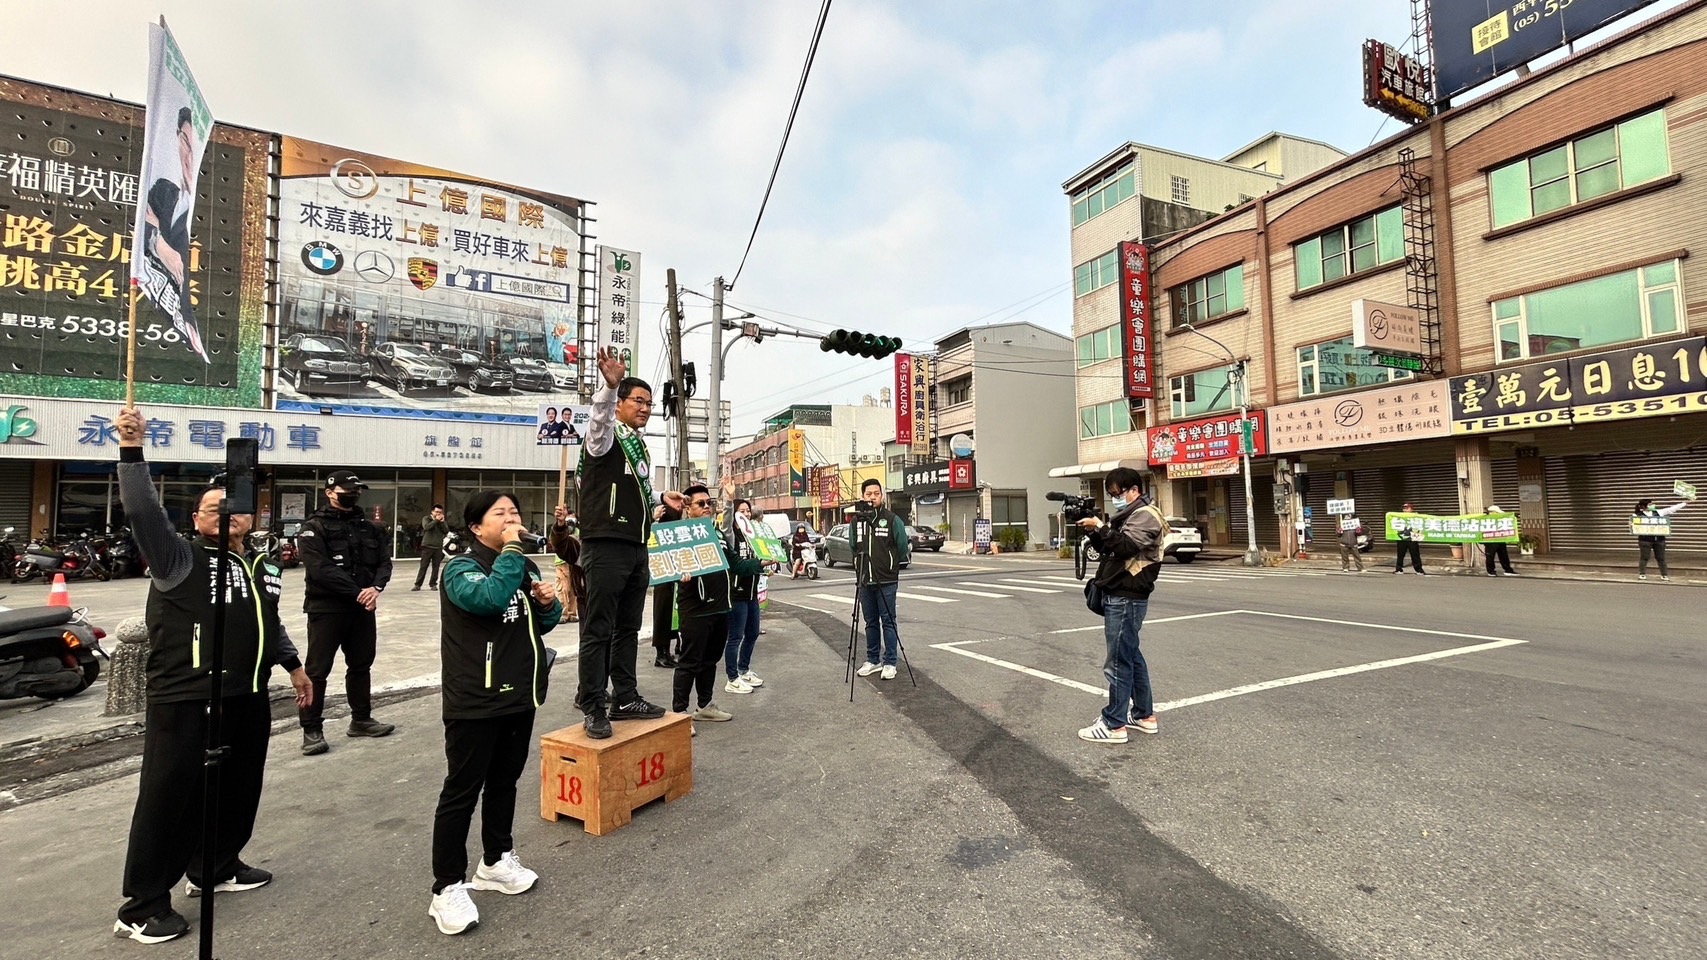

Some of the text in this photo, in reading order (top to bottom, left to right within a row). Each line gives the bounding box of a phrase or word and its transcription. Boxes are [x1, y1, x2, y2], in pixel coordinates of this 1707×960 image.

[1477, 19, 1501, 38] 接待
[1479, 30, 1502, 47] 會館
[1381, 67, 1424, 102] 汽車旅館
[396, 178, 545, 230] 上億國際
[1, 313, 57, 330] 星巴克
[611, 274, 626, 345] 永帝綠能
[1130, 277, 1148, 385] 童樂會團購網
[900, 373, 908, 417] SAKURA
[648, 542, 723, 580] 劉建國
[634, 752, 666, 788] 18
[557, 773, 583, 806] 18
